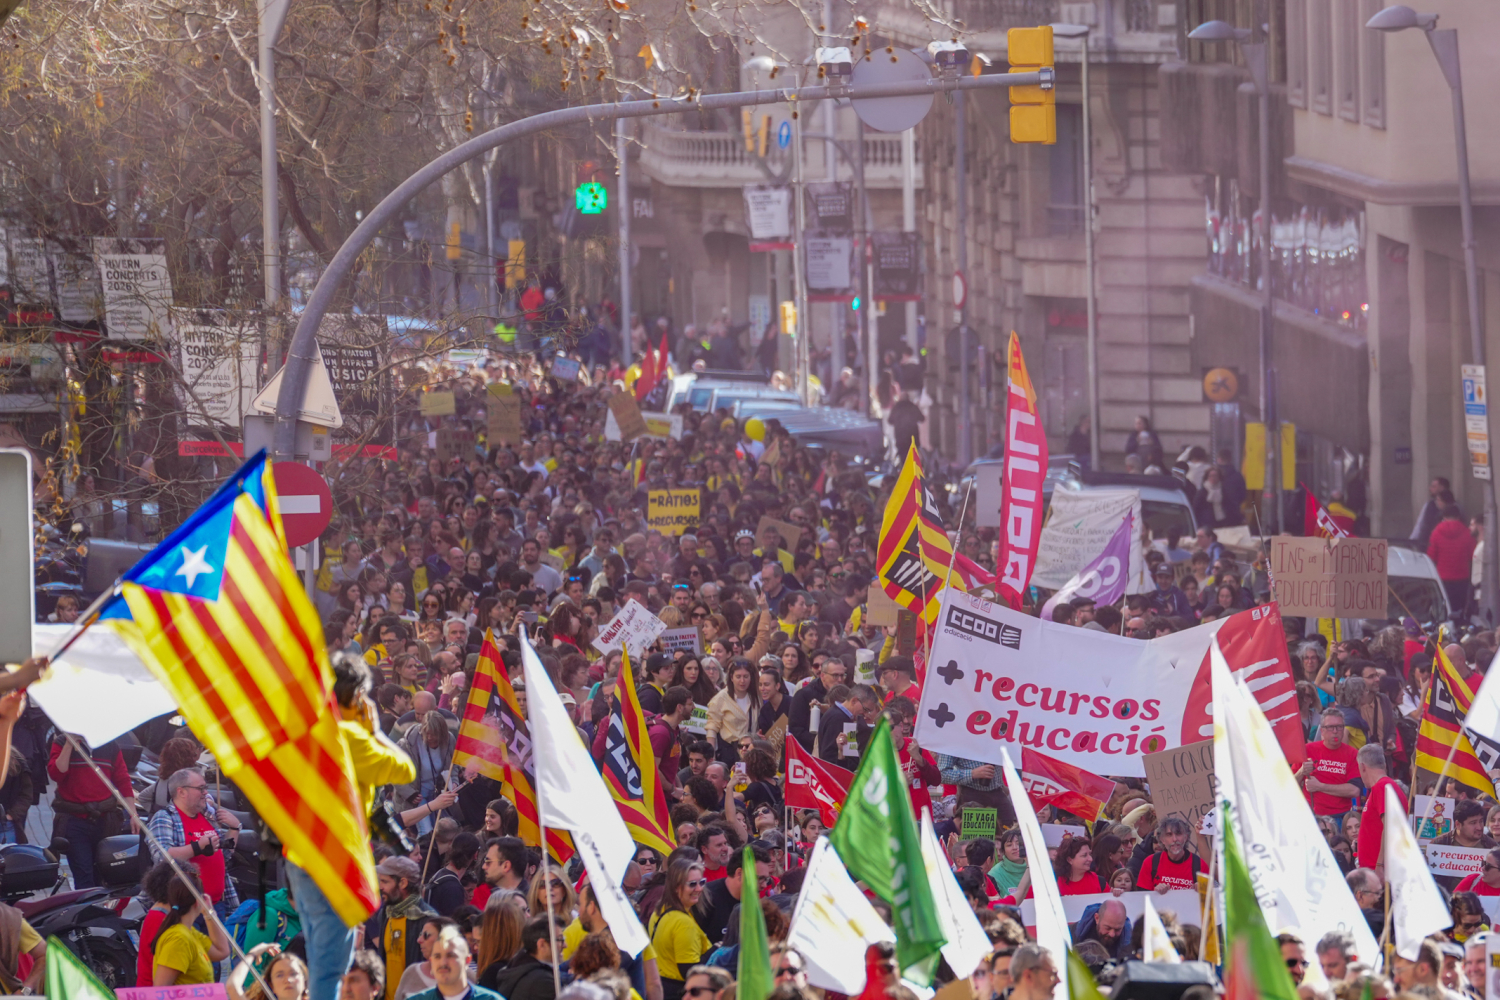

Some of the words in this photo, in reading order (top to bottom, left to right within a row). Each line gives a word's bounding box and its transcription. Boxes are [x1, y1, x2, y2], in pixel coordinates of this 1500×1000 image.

[104, 259, 140, 269] HIVERN
[106, 270, 157, 280] CONCERTS
[107, 281, 132, 291] 2026
[184, 443, 225, 454] Barcelona
[1276, 542, 1305, 574] INS
[950, 609, 998, 639] CCOO
[943, 627, 973, 643] educació
[974, 667, 1162, 722] recursos
[965, 708, 1168, 757] educació
[1318, 758, 1348, 769] recursos
[1151, 760, 1170, 781] LA
[1316, 765, 1347, 775] educació
[1159, 778, 1201, 807] TAMBÉ
[963, 812, 974, 821] 11F
[975, 812, 995, 822] VAGA
[963, 821, 995, 829] EDUCATIVA
[1439, 851, 1485, 862] recursos
[1160, 875, 1193, 885] recursos
[155, 987, 214, 1000] JUGUEU
